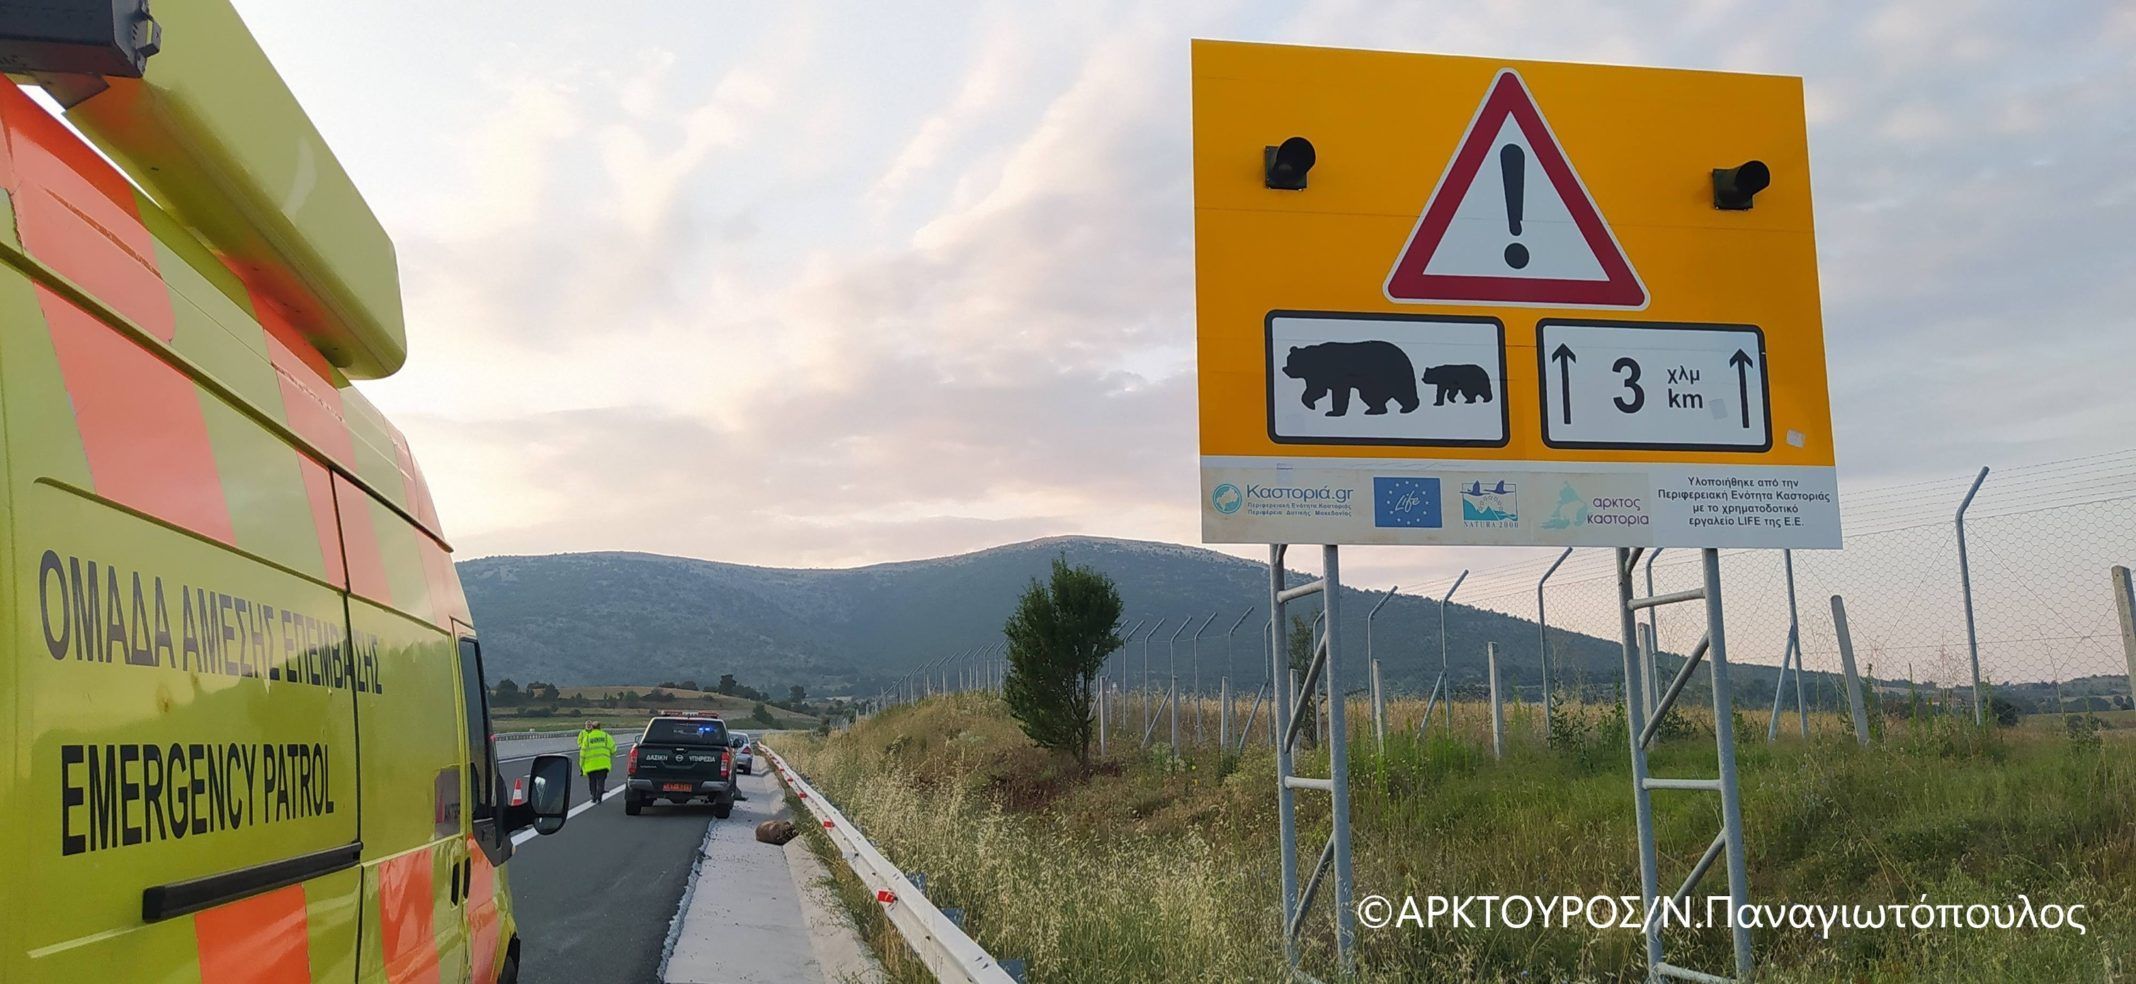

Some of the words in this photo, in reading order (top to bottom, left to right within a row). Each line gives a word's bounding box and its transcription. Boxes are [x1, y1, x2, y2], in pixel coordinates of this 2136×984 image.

[1667, 365, 1700, 384] χλμ
[1612, 357, 1645, 414] 3
[1668, 388, 1703, 409] km
[1688, 476, 1755, 489] Υλοποιήθηκε
[1757, 478, 1779, 488] από
[1781, 480, 1799, 489] την
[1247, 484, 1354, 503] Καστοριά.gr
[1395, 490, 1420, 513] Life
[1658, 489, 1728, 501] Περιφερειακή
[1731, 490, 1773, 501] Ενότητα
[1776, 491, 1831, 503] Καστοριάς
[1592, 497, 1641, 511] αρκτος
[1692, 504, 1705, 513] με
[1722, 504, 1799, 516] χρηματοδοτικό
[1587, 514, 1649, 527] καστορια
[1689, 517, 1735, 528] εργαλείο
[1738, 518, 1761, 526] LIFE
[1764, 519, 1782, 529] της
[39, 550, 176, 668] ΟΜΑΔΑ
[182, 585, 280, 681] ΑΜΕΣΗΣ
[689, 755, 716, 763] ΥΠΗΡΕΣΙΑ
[62, 743, 257, 856] EMERGENCY
[263, 743, 334, 823] PATROL
